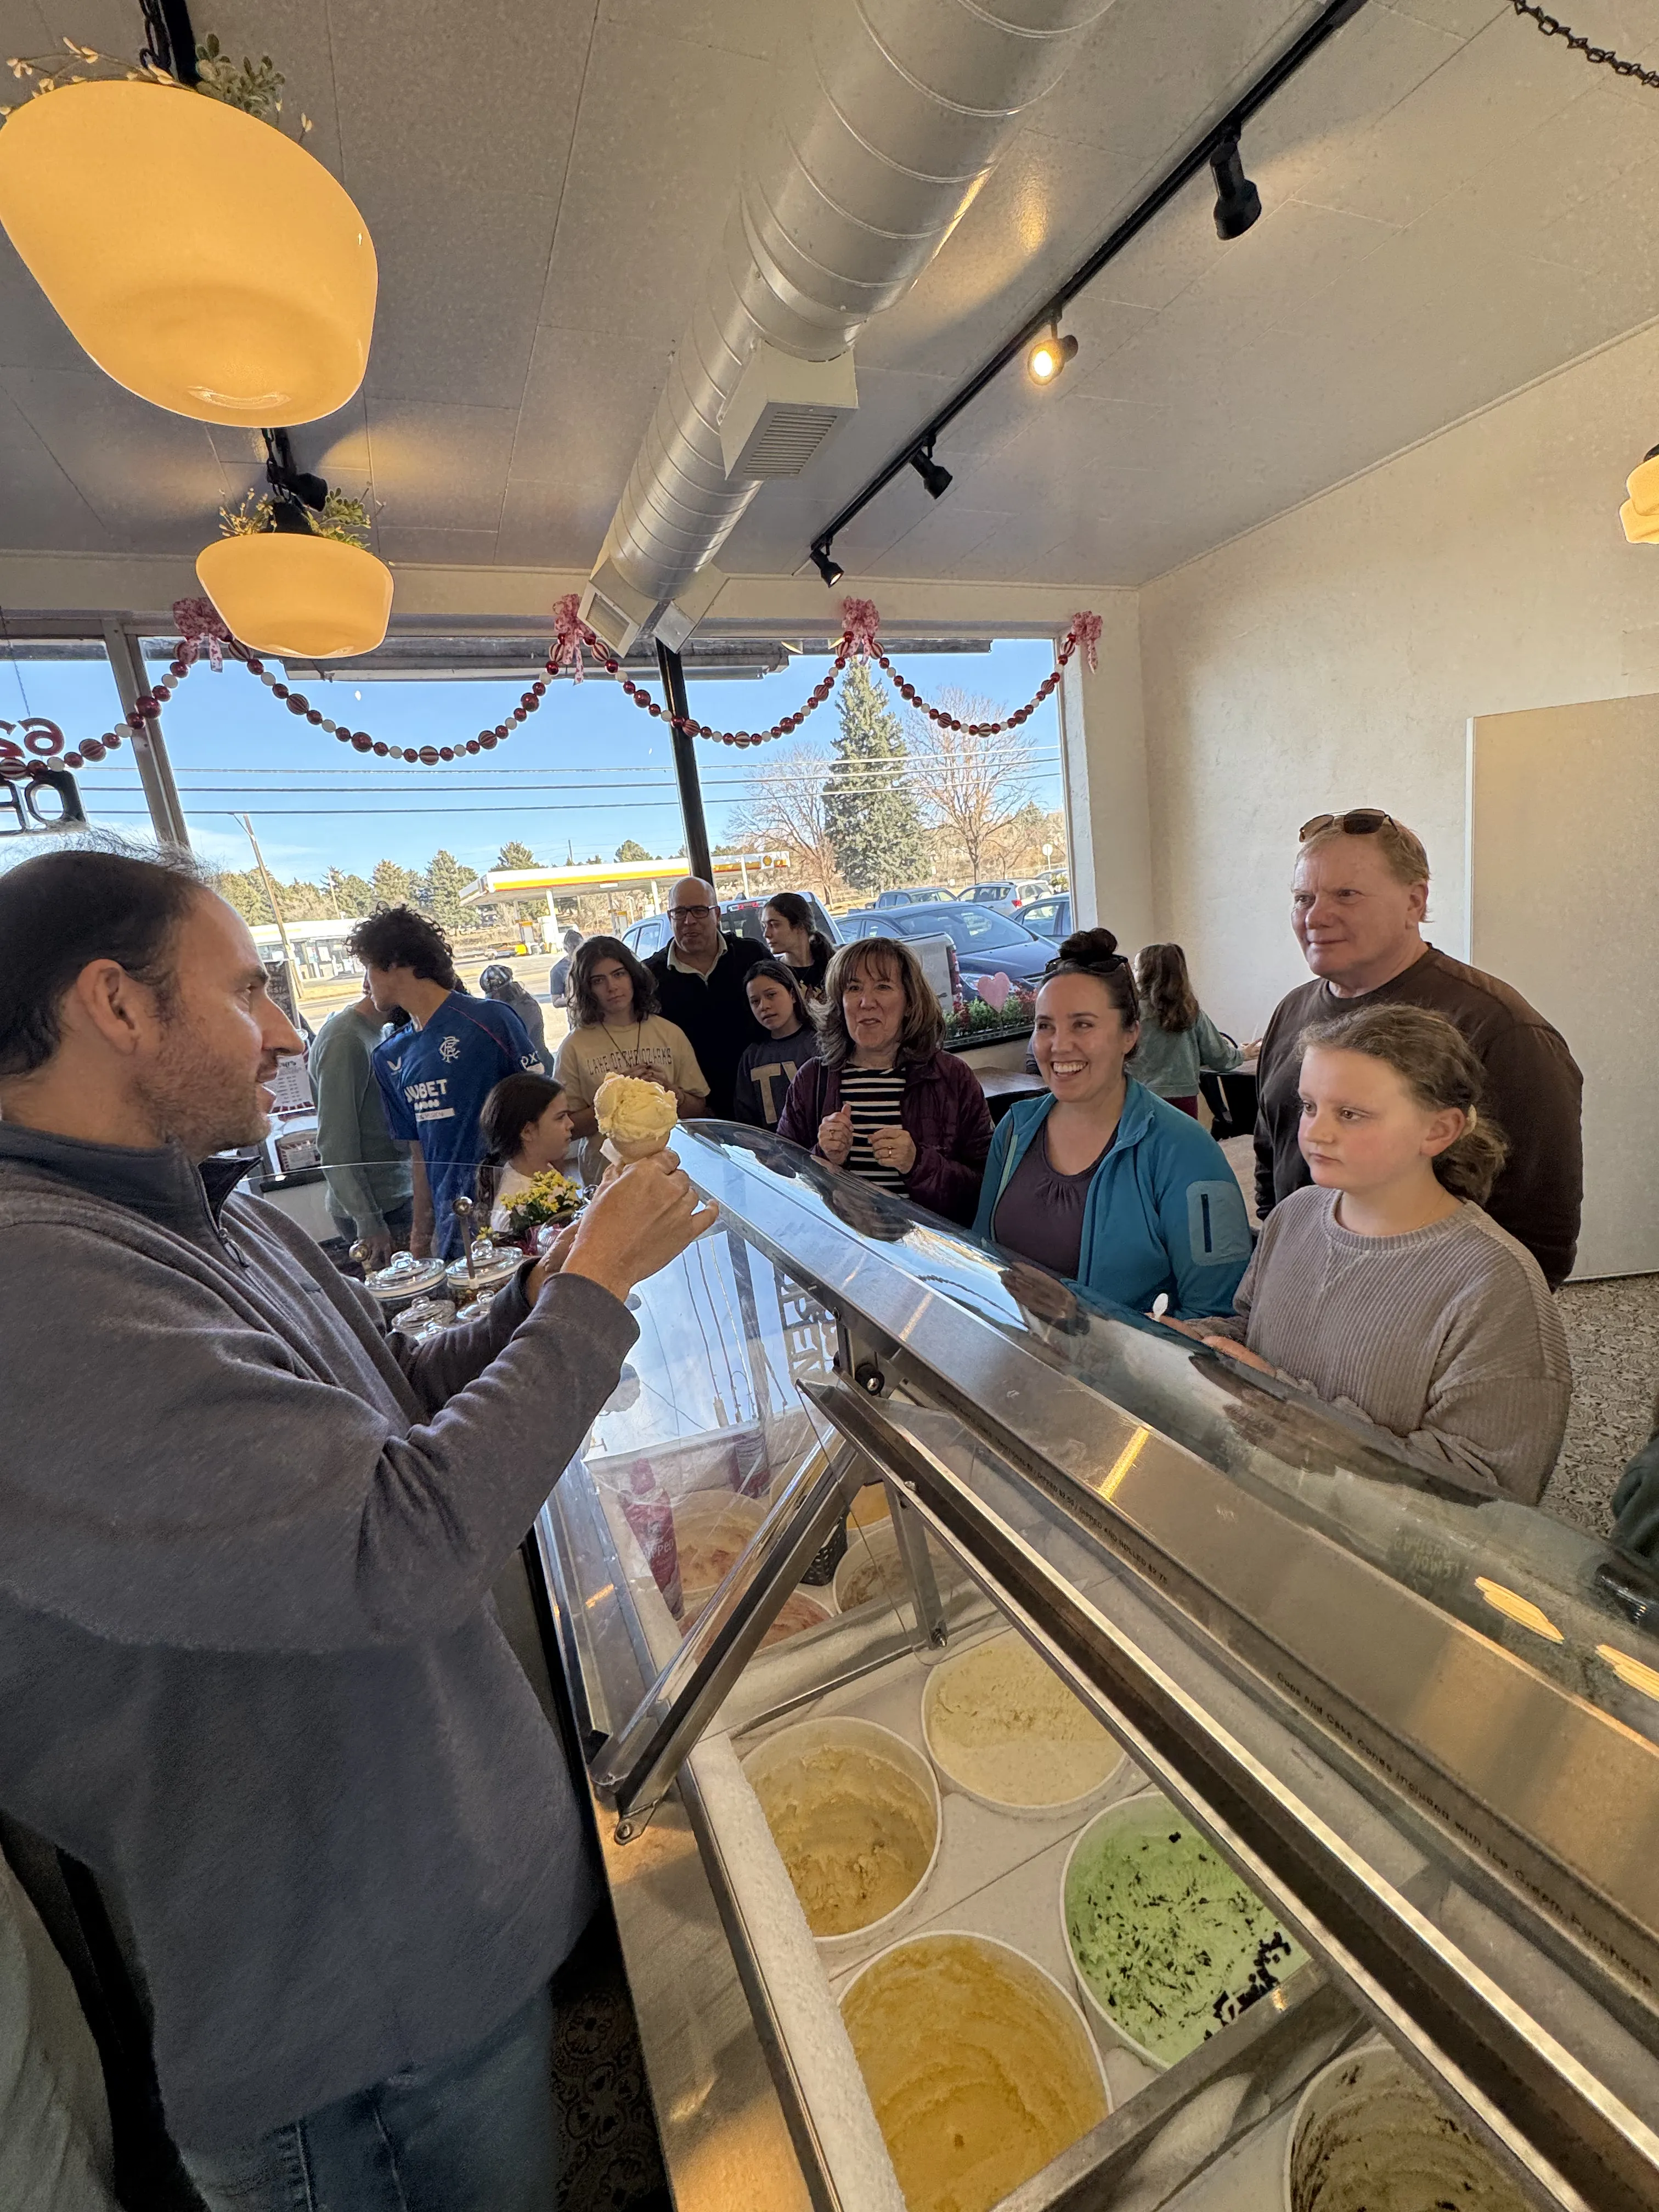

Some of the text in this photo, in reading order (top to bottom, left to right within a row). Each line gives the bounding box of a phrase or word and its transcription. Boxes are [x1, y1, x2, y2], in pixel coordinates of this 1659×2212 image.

[586, 1056, 610, 1075] LAKE
[610, 1052, 622, 1070] OF
[641, 1047, 672, 1065] OZARKS
[1079, 1506, 1103, 1529] DIPPED
[1358, 1739, 1393, 1774] Cones
